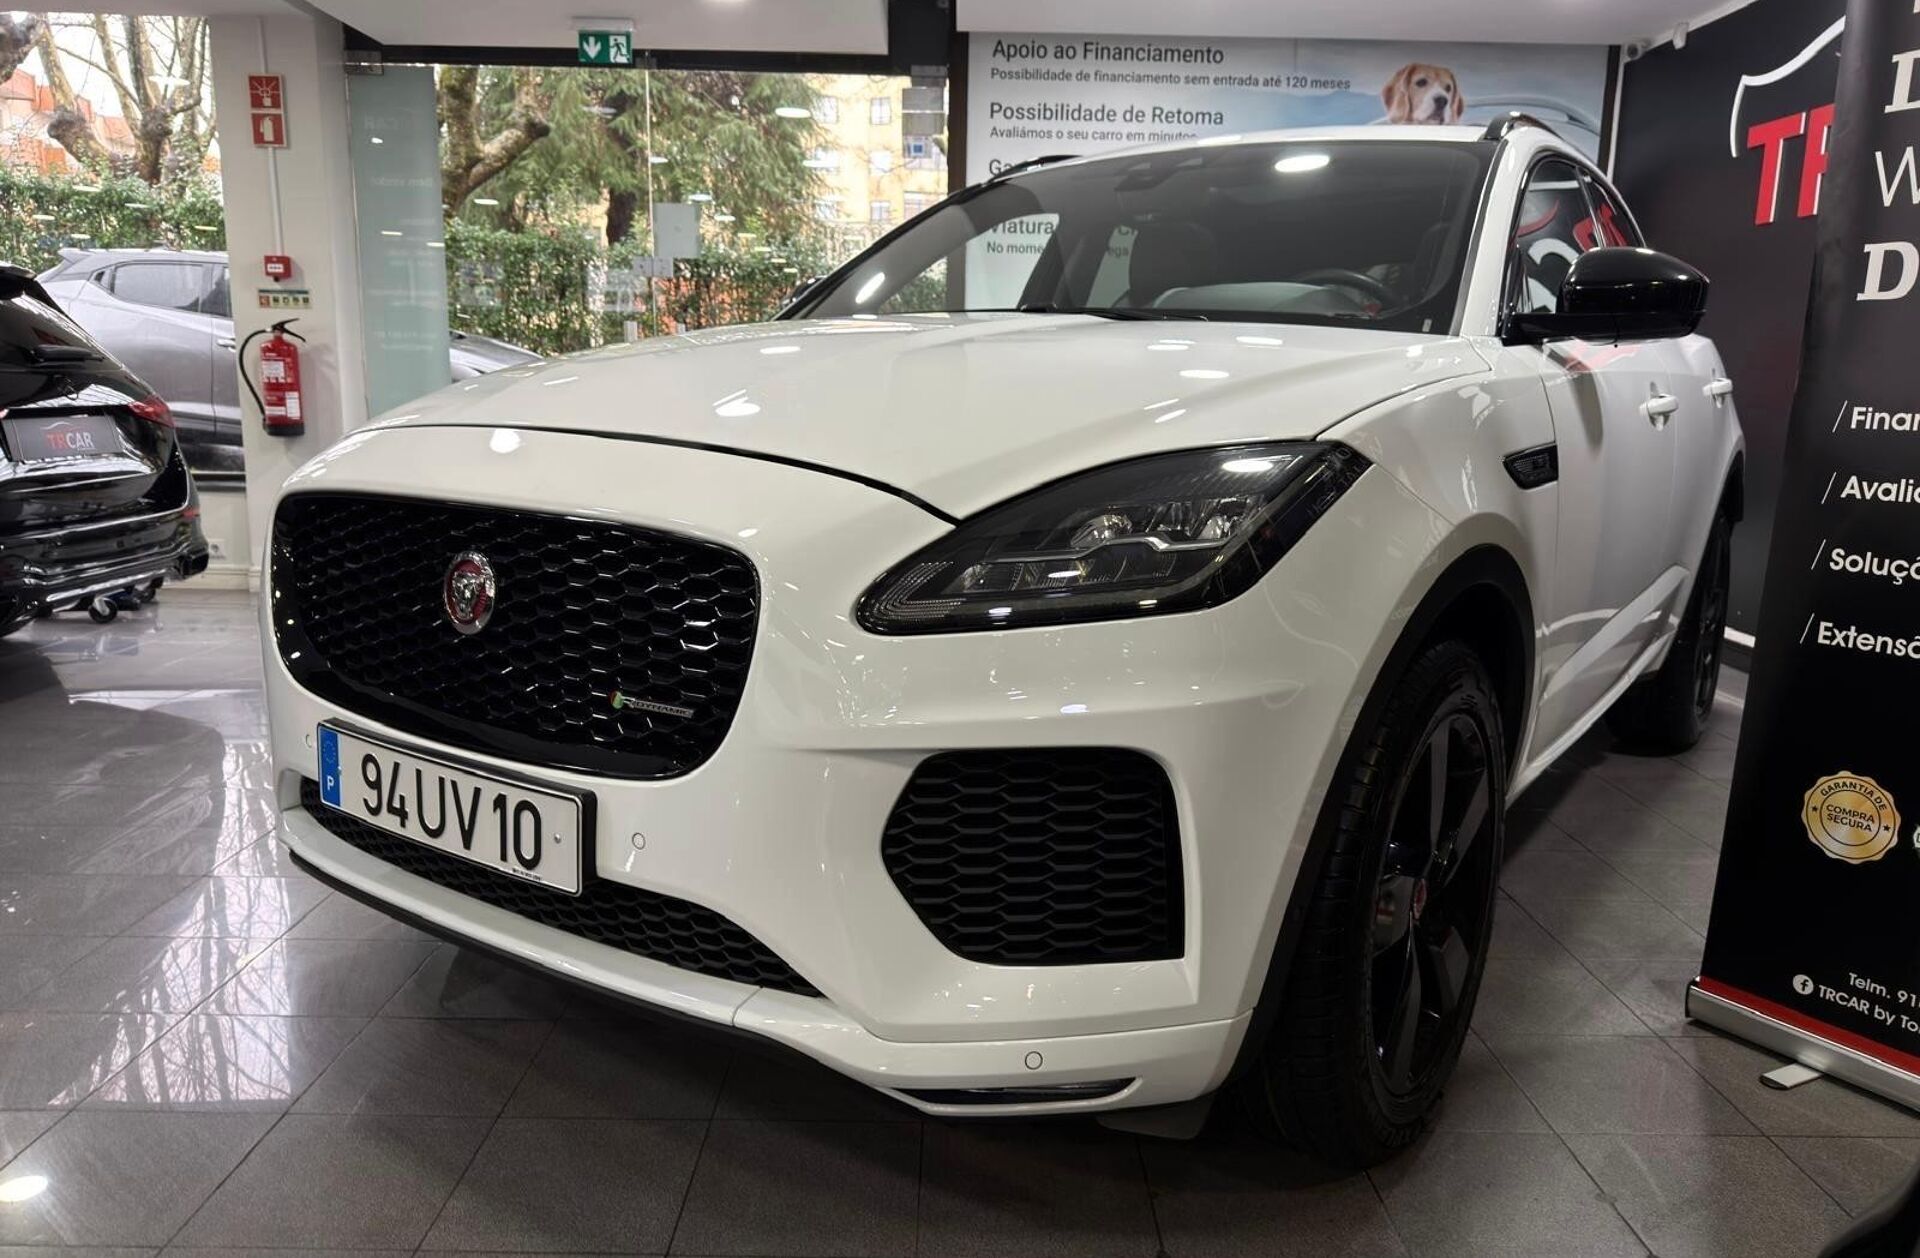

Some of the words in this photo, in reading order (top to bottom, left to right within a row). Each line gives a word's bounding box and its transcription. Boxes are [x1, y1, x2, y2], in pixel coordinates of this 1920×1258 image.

[992, 39, 1048, 62] Apoio
[1053, 44, 1077, 60] ao
[1083, 41, 1225, 64] Financiamento
[990, 67, 1072, 82] Possibilidade
[1075, 70, 1091, 82] de
[1094, 70, 1181, 84] financiamento
[1184, 75, 1210, 86] sem
[1213, 73, 1259, 88] entrada
[1262, 73, 1282, 88] até
[1286, 76, 1308, 89] 120
[1310, 78, 1351, 90] meses
[989, 102, 1117, 122] Possibilidade
[1122, 104, 1146, 123] de
[1151, 106, 1224, 125] Retoma
[990, 126, 1053, 140] Avaliámos
[1055, 130, 1064, 141] o
[1067, 131, 1089, 141] seu
[1091, 131, 1124, 142] carro
[1126, 131, 1145, 142] em
[987, 241, 1004, 254] No
[1856, 241, 1920, 301] D
[45, 431, 95, 450] TRCAR
[327, 776, 335, 792] P
[1820, 780, 1875, 798] GARANTIA
[1874, 795, 1887, 811] DE
[1826, 803, 1875, 824] COMPRA
[1826, 813, 1873, 832] SEGURA
[1849, 972, 1891, 999] Telm.
[1819, 984, 1869, 1015] TRCAR
[1874, 1004, 1896, 1026] by
